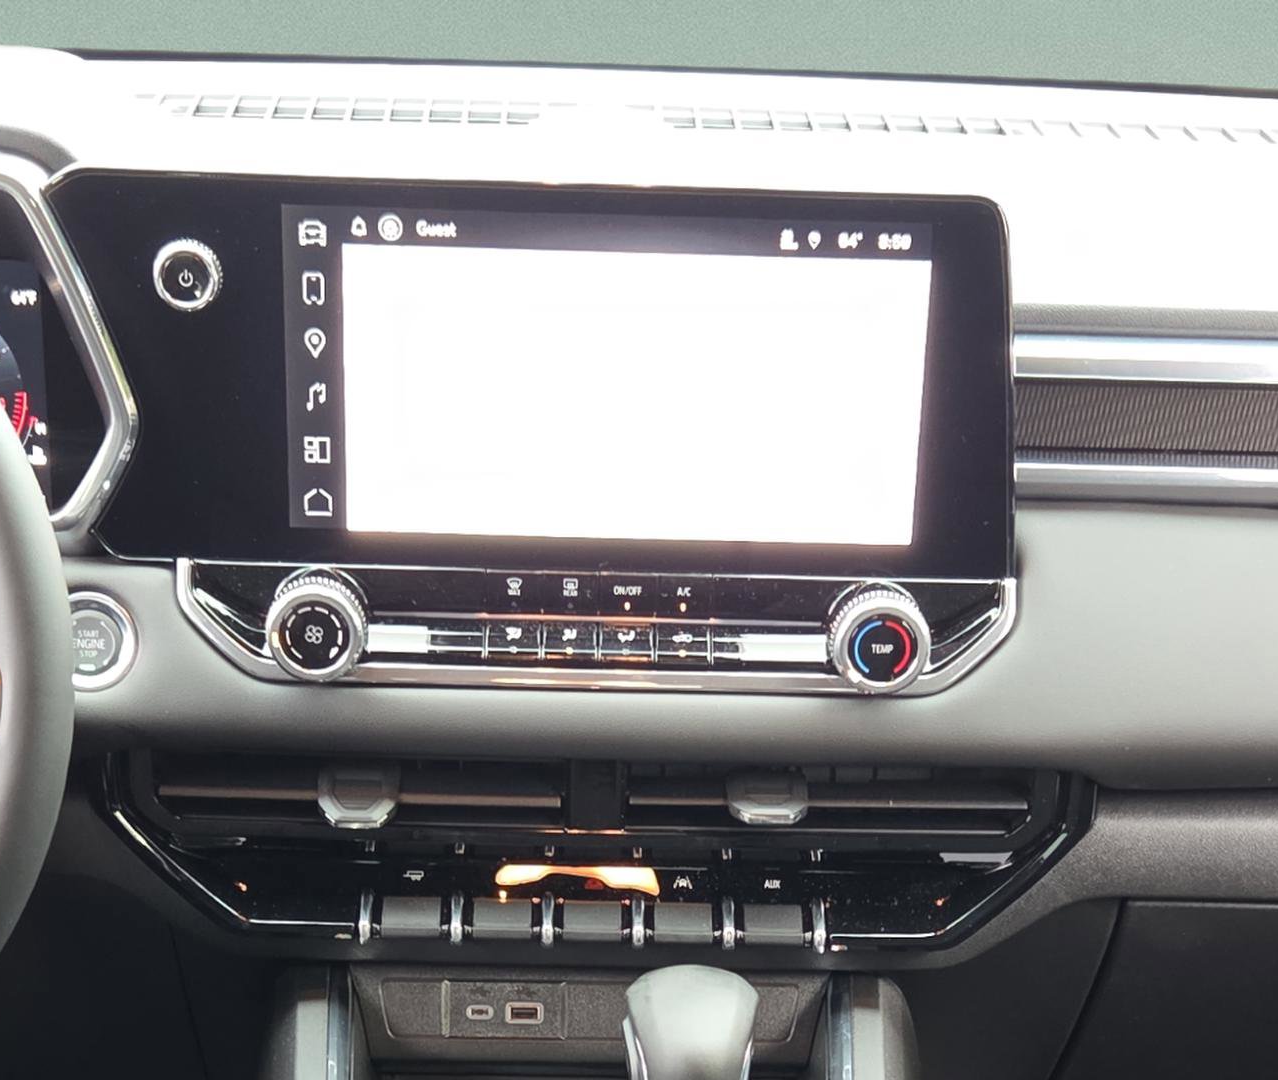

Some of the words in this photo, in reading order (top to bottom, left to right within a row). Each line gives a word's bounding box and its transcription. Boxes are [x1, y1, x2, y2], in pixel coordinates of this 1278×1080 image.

[613, 585, 643, 596] ON/OFF
[677, 587, 691, 597] A/C
[77, 630, 99, 638] START
[73, 638, 106, 650] ENGINE
[871, 644, 894, 654] TEMP
[79, 650, 98, 658] STOP
[764, 879, 781, 889] AUX
